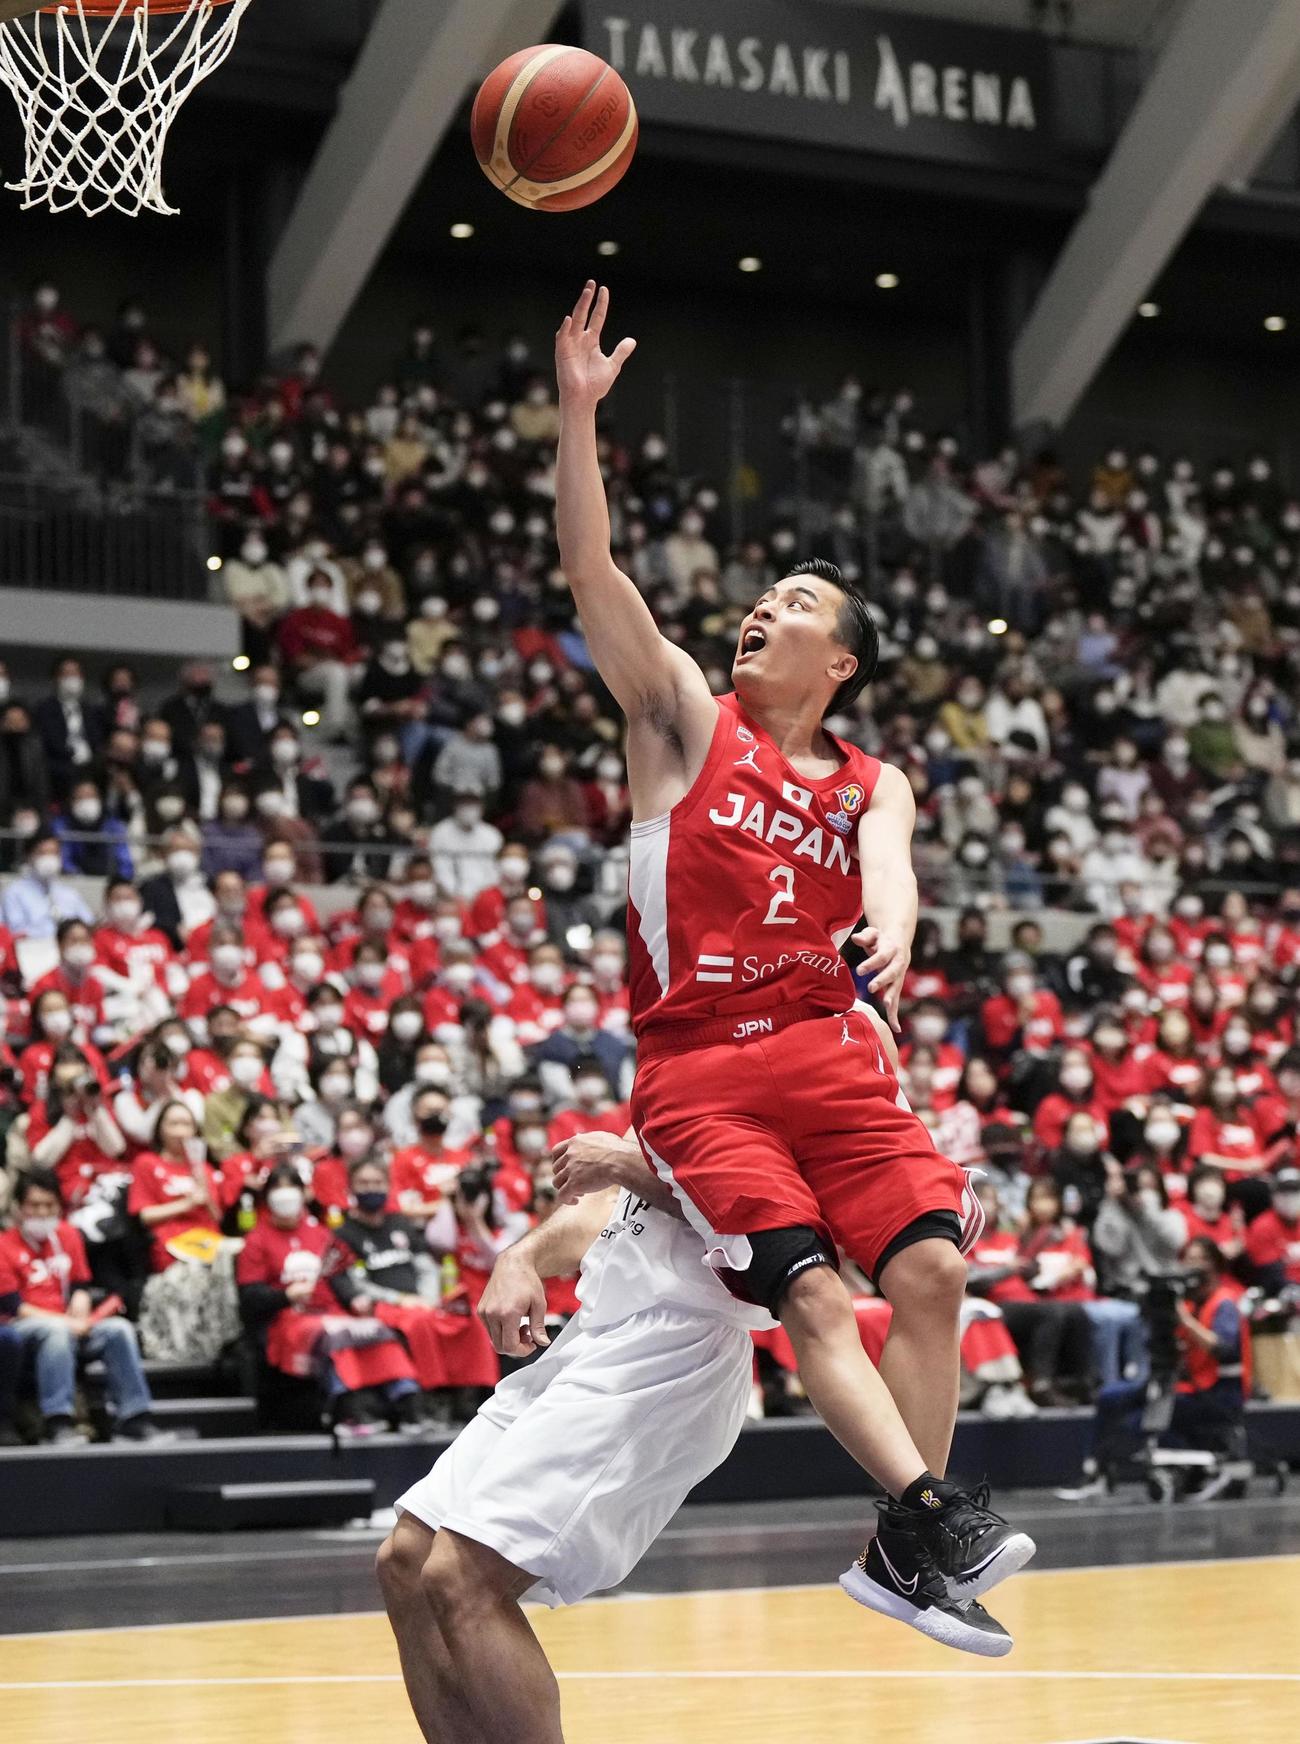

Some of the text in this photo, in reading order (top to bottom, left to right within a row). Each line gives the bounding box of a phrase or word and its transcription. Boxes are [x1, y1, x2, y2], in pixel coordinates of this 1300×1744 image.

[604, 17, 1036, 130] TAKASAKI ARENA
[573, 94, 620, 151] molten
[709, 793, 851, 877] JAPAN
[762, 864, 799, 924] 2
[733, 1017, 773, 1039] JPN
